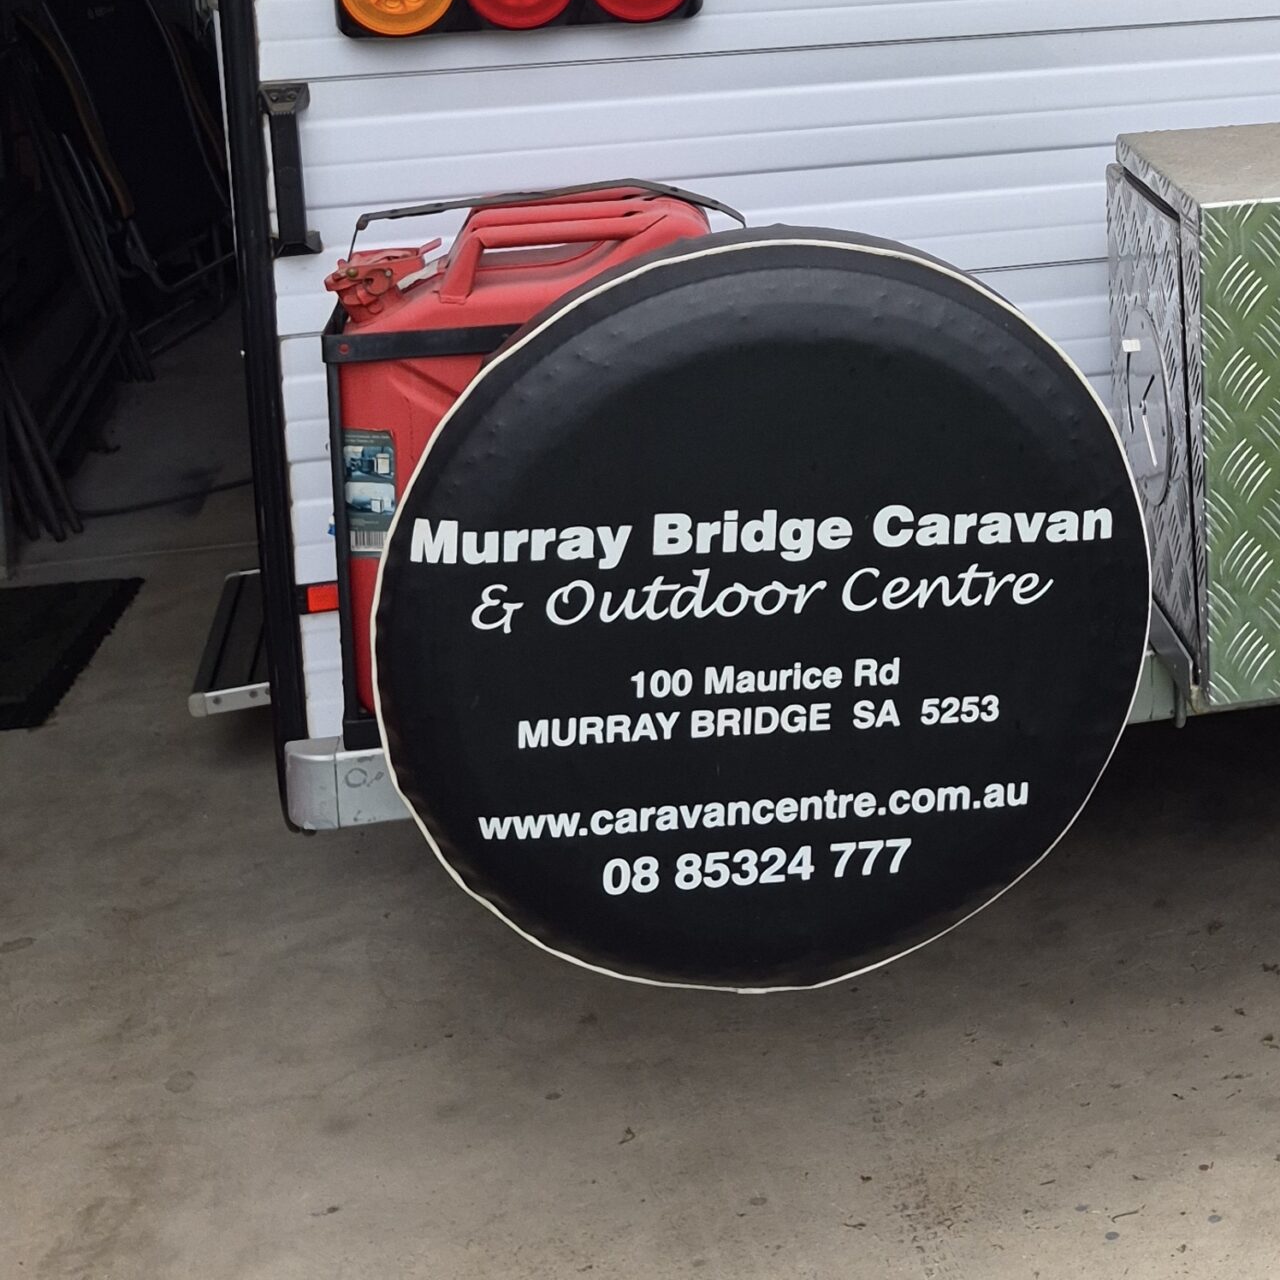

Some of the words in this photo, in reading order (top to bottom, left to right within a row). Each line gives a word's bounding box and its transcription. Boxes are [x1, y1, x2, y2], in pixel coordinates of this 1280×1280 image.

[409, 518, 634, 571] Murray
[651, 508, 854, 563] Bridge
[872, 503, 1114, 549] Caravan
[470, 582, 525, 635] &
[545, 566, 828, 627] Outdoor
[840, 562, 1055, 613] Centre
[629, 668, 694, 700] 100
[703, 662, 844, 696] Maurice
[853, 656, 902, 688] Rd
[517, 711, 682, 750] MURRAY
[689, 701, 833, 740] BRIDGE
[851, 698, 902, 731] SA
[919, 693, 1001, 727] 5253
[478, 780, 1030, 841] www.caravancentre.com.au
[601, 854, 661, 897] 08
[673, 844, 816, 892] 85324
[828, 836, 913, 879] 777
